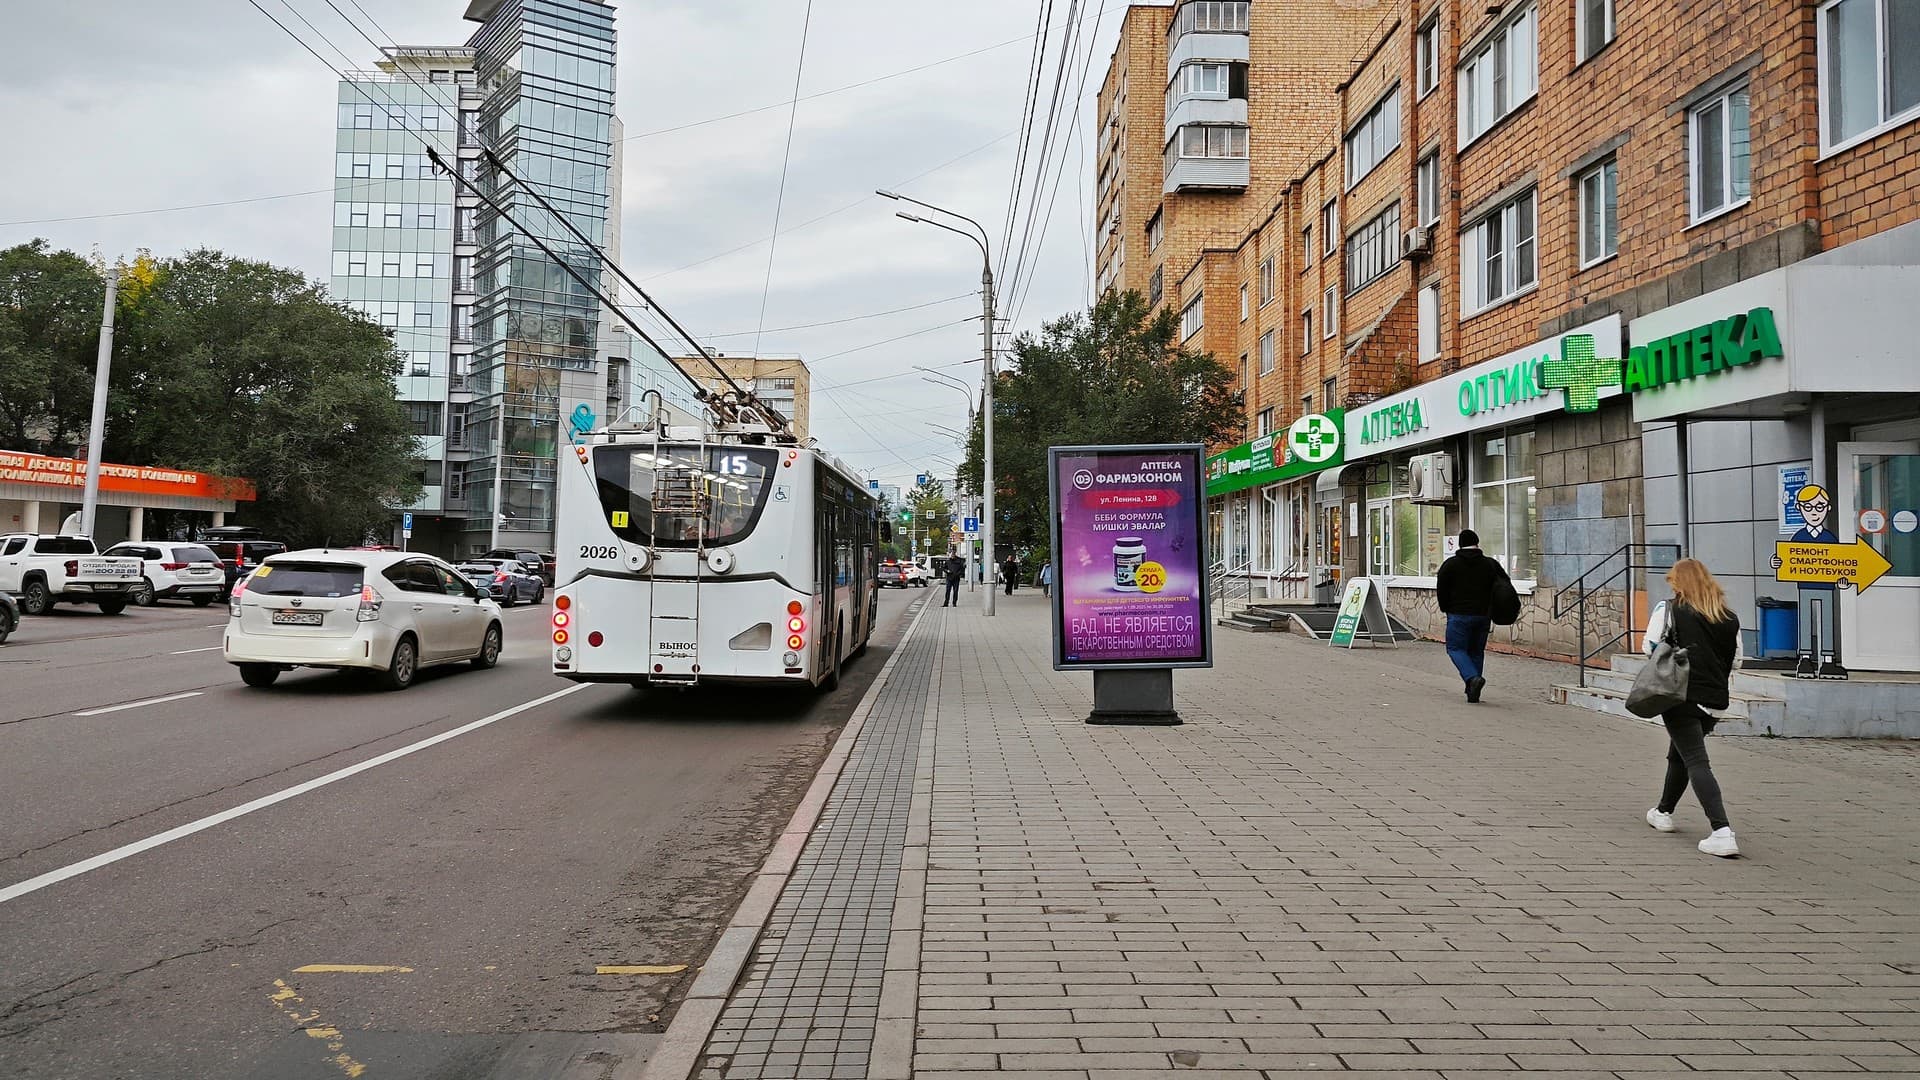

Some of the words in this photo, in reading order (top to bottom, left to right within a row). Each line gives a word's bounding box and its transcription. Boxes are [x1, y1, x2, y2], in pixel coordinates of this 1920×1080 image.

[1623, 307, 1783, 393] АПТЕКА
[1360, 397, 1424, 445] АПТЕКА
[1458, 353, 1549, 417] ОПТИК
[720, 455, 748, 475] 15
[1141, 461, 1182, 470] АПТЕКА
[1096, 472, 1182, 484] ФАРМЭКОНОМ
[1113, 495, 1143, 504] Ленина,
[1094, 513, 1117, 522] БЕБИ
[1119, 512, 1164, 521] ФОРМУЛА
[1092, 522, 1129, 531] МИШКИ
[1131, 521, 1166, 531] ЭВАЛАР
[580, 545, 618, 560] 2026
[1789, 547, 1830, 556] РЕМОНТ
[1789, 557, 1858, 567] СМАРТФОНОВ
[1789, 566, 1797, 575] И
[1799, 566, 1857, 577] НОУТБУКОВ
[1098, 609, 1167, 617] www.pharmeconom.ru
[1104, 617, 1121, 633] НЕ
[1125, 615, 1194, 633] ЯВЛЯЕТСЯ
[659, 641, 697, 651] ВЫНОС
[1071, 635, 1143, 651] ЛЕКАРСТВЕННЫМ
[1145, 634, 1194, 650] СРЕДСТВОМ
